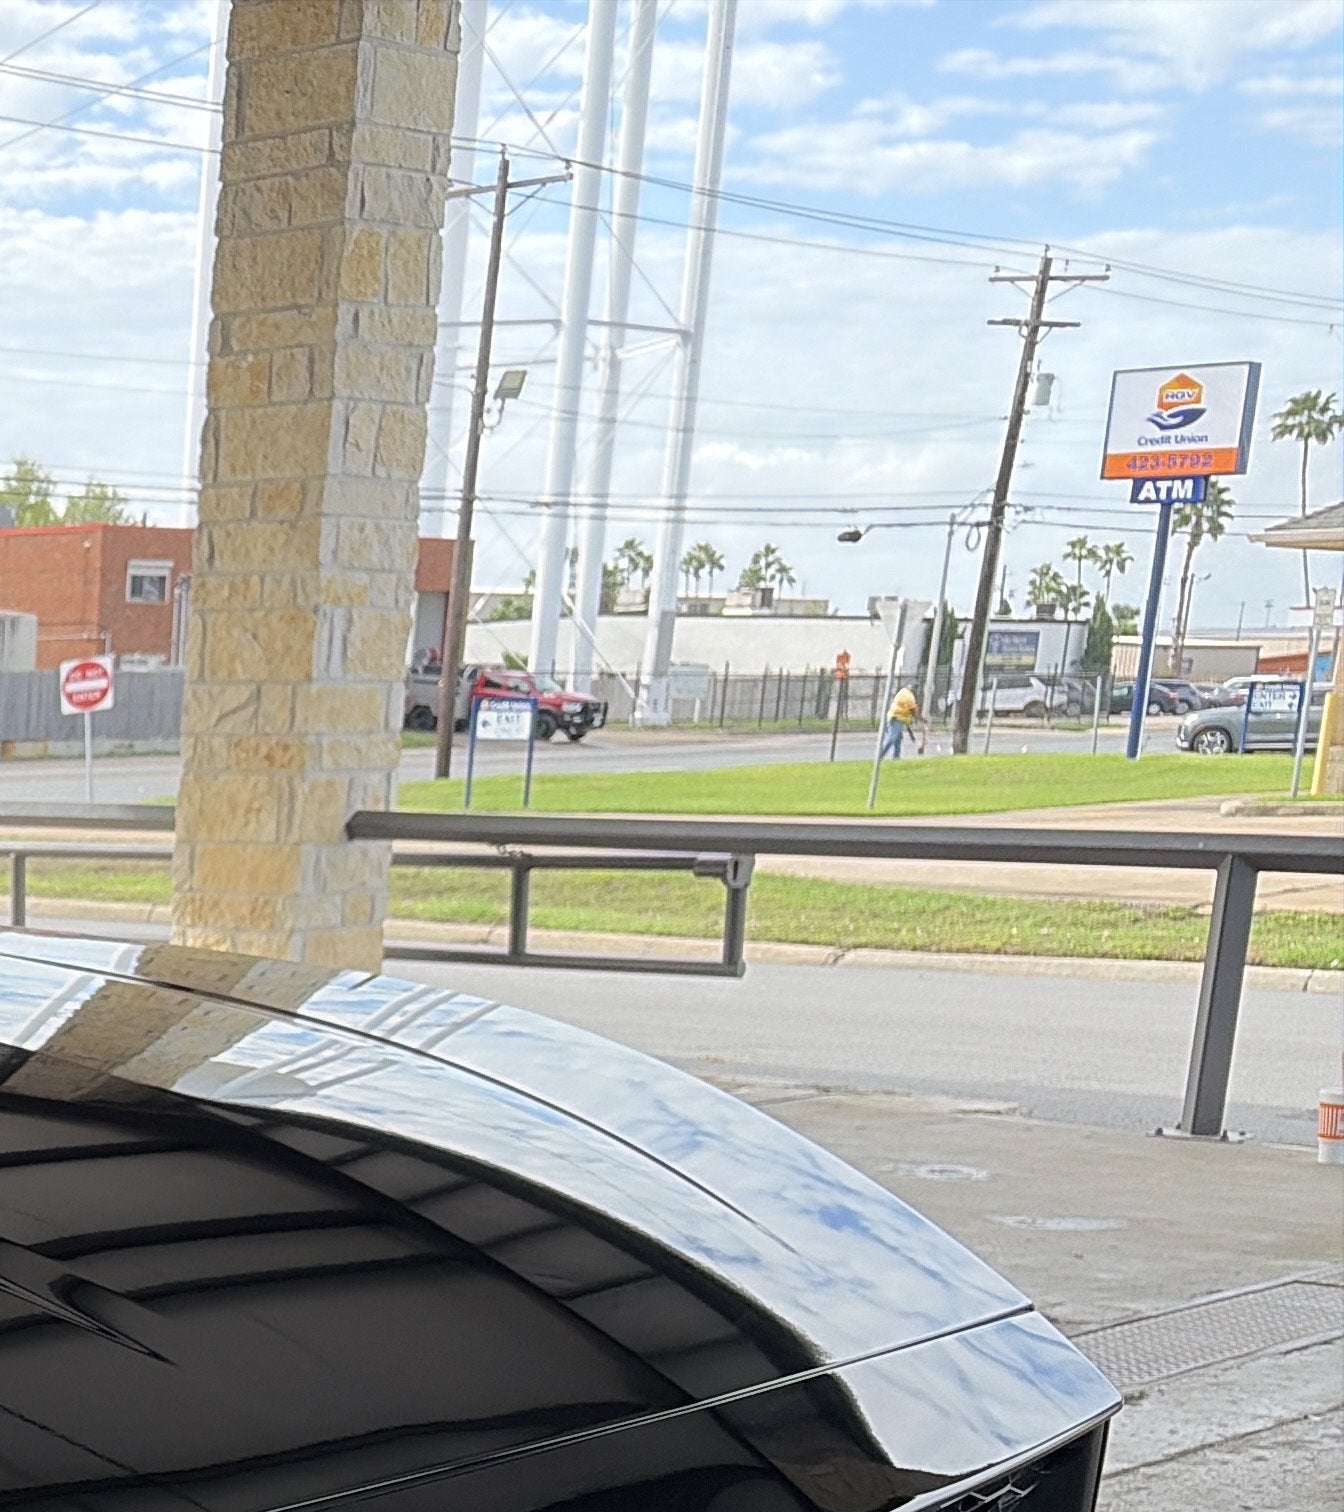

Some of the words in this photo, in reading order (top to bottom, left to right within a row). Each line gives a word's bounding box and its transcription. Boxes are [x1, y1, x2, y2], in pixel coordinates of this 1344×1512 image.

[1137, 434, 1172, 446] Credit
[1175, 433, 1209, 444] Union
[1138, 479, 1194, 500] ATM
